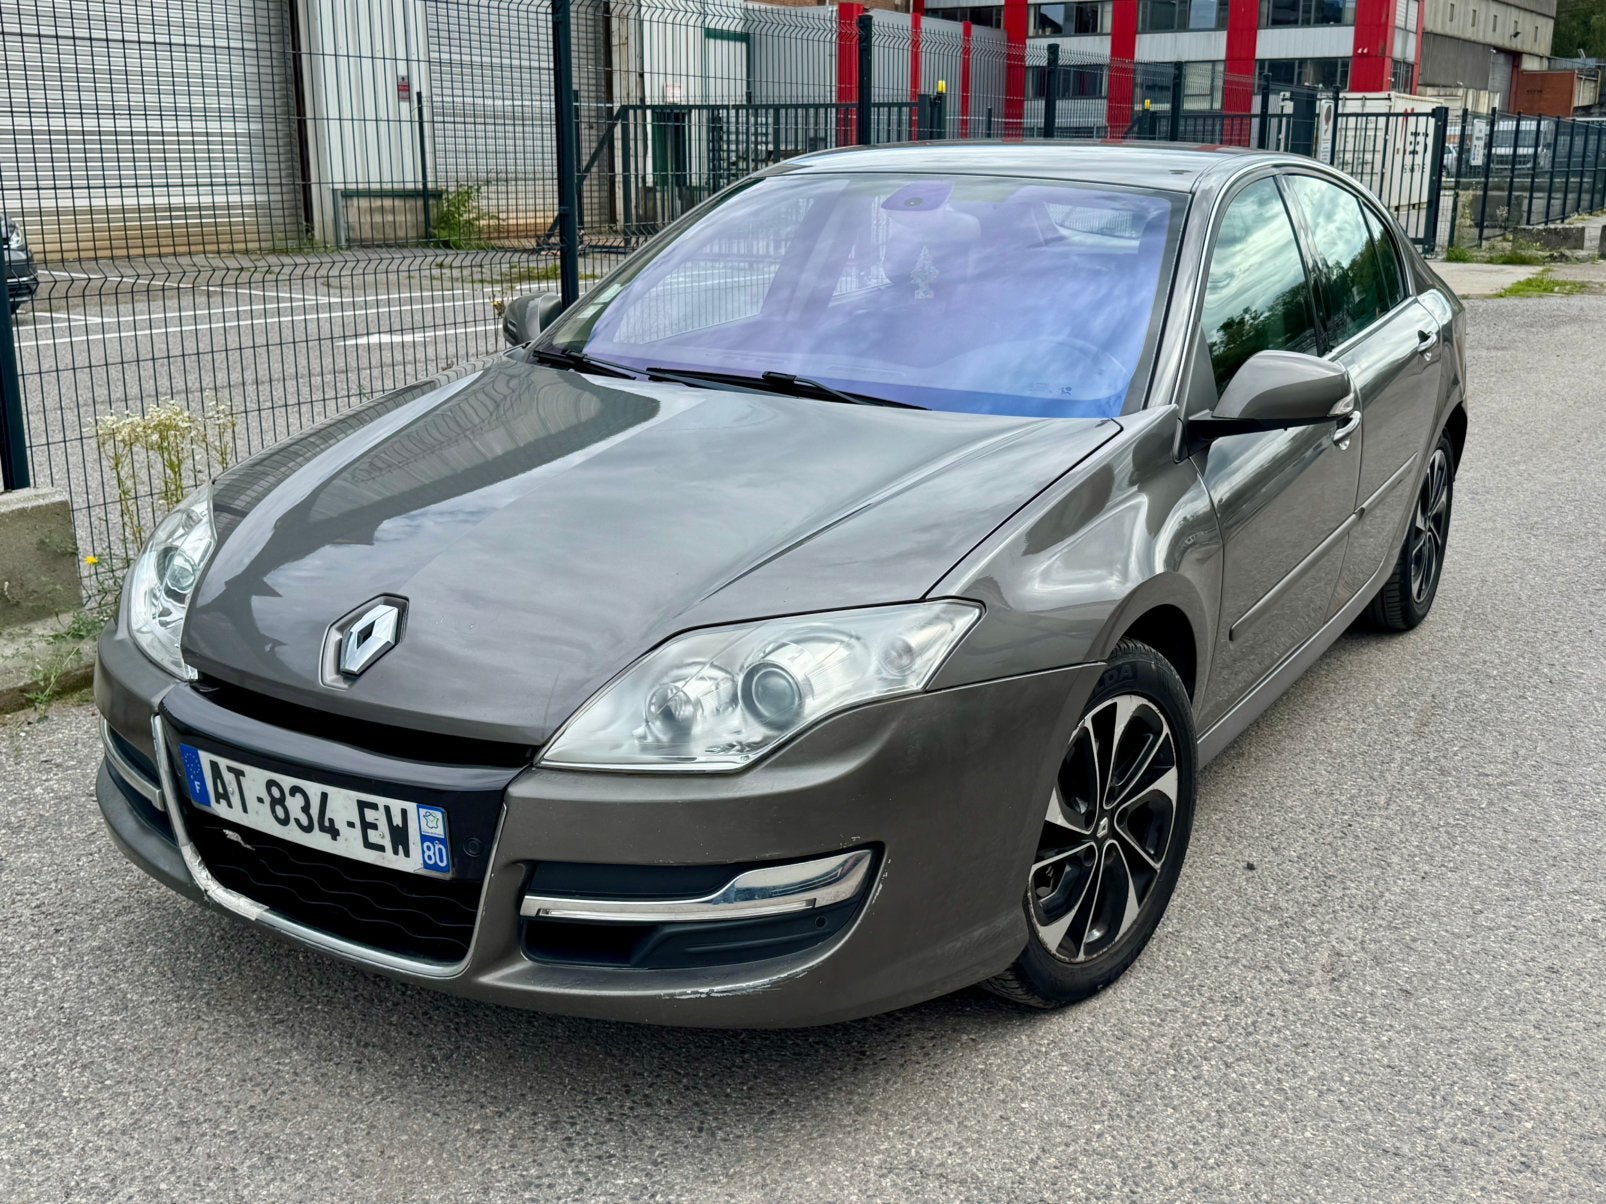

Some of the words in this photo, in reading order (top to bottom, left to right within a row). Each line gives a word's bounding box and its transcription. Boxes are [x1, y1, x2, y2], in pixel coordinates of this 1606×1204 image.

[194, 780, 201, 794] F
[209, 759, 410, 859] AT-834-EW
[423, 841, 447, 867] 80
